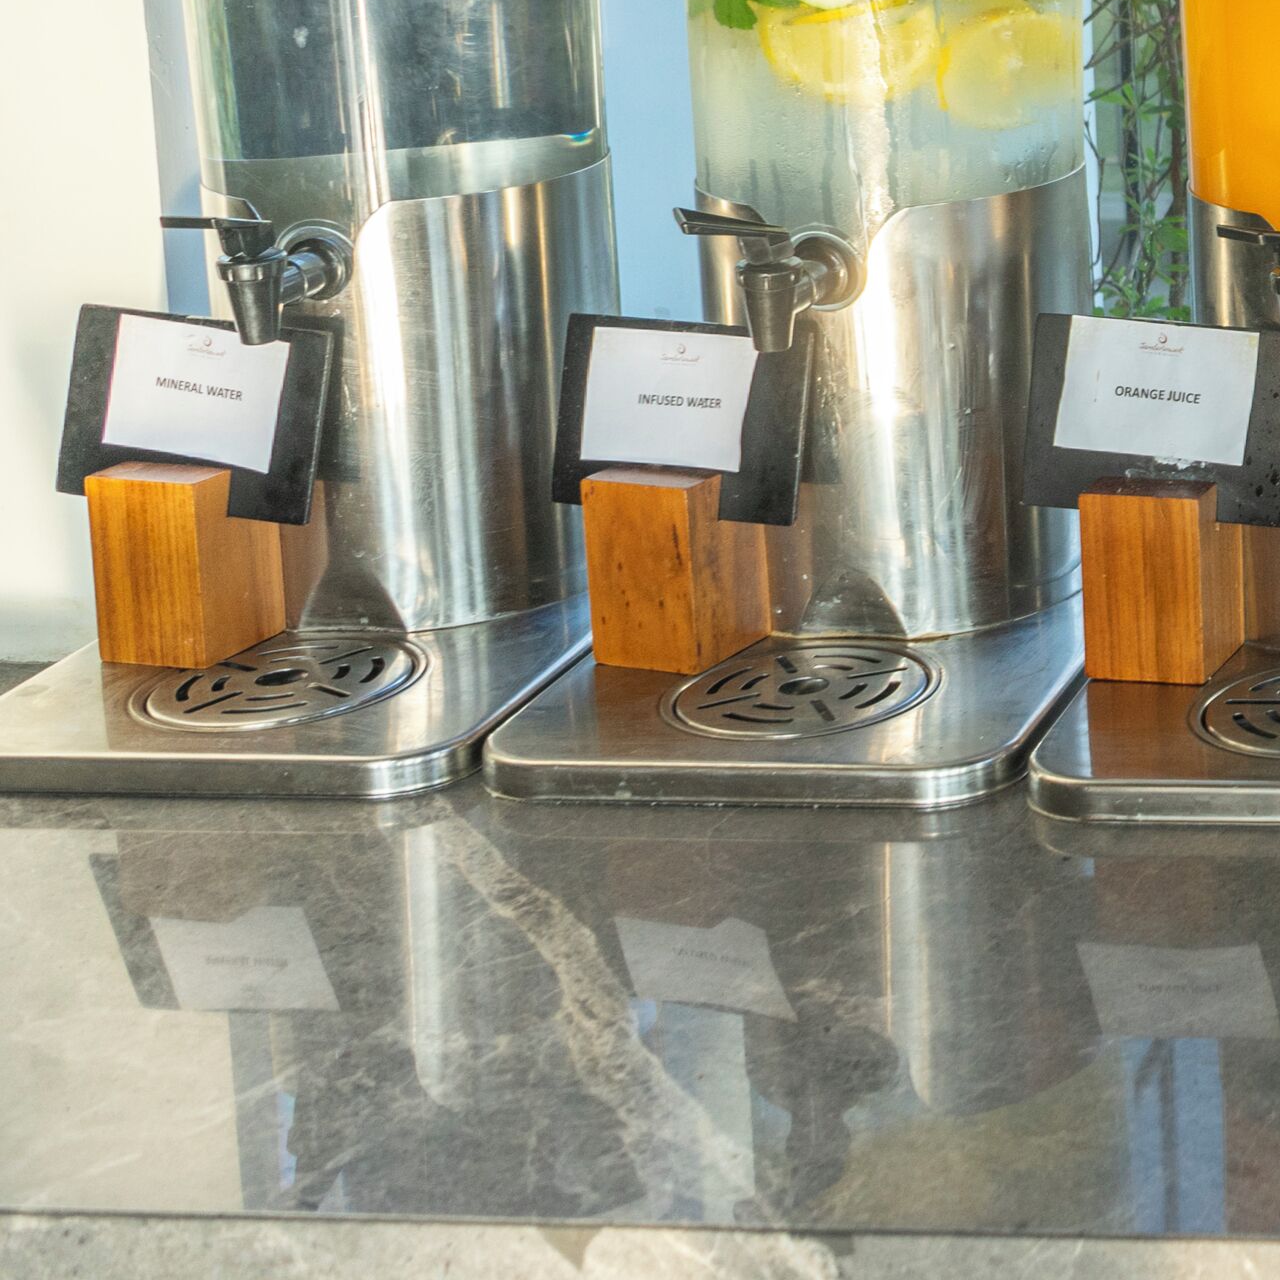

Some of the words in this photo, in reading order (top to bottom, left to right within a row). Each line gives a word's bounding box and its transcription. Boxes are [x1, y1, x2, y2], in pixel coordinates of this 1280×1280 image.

[156, 376, 203, 394] MINERAL
[206, 385, 242, 401] WATER
[1114, 385, 1165, 401] ORANGE
[1167, 389, 1201, 404] JUICE
[638, 393, 684, 407] INFUSED
[686, 396, 722, 409] WATER
